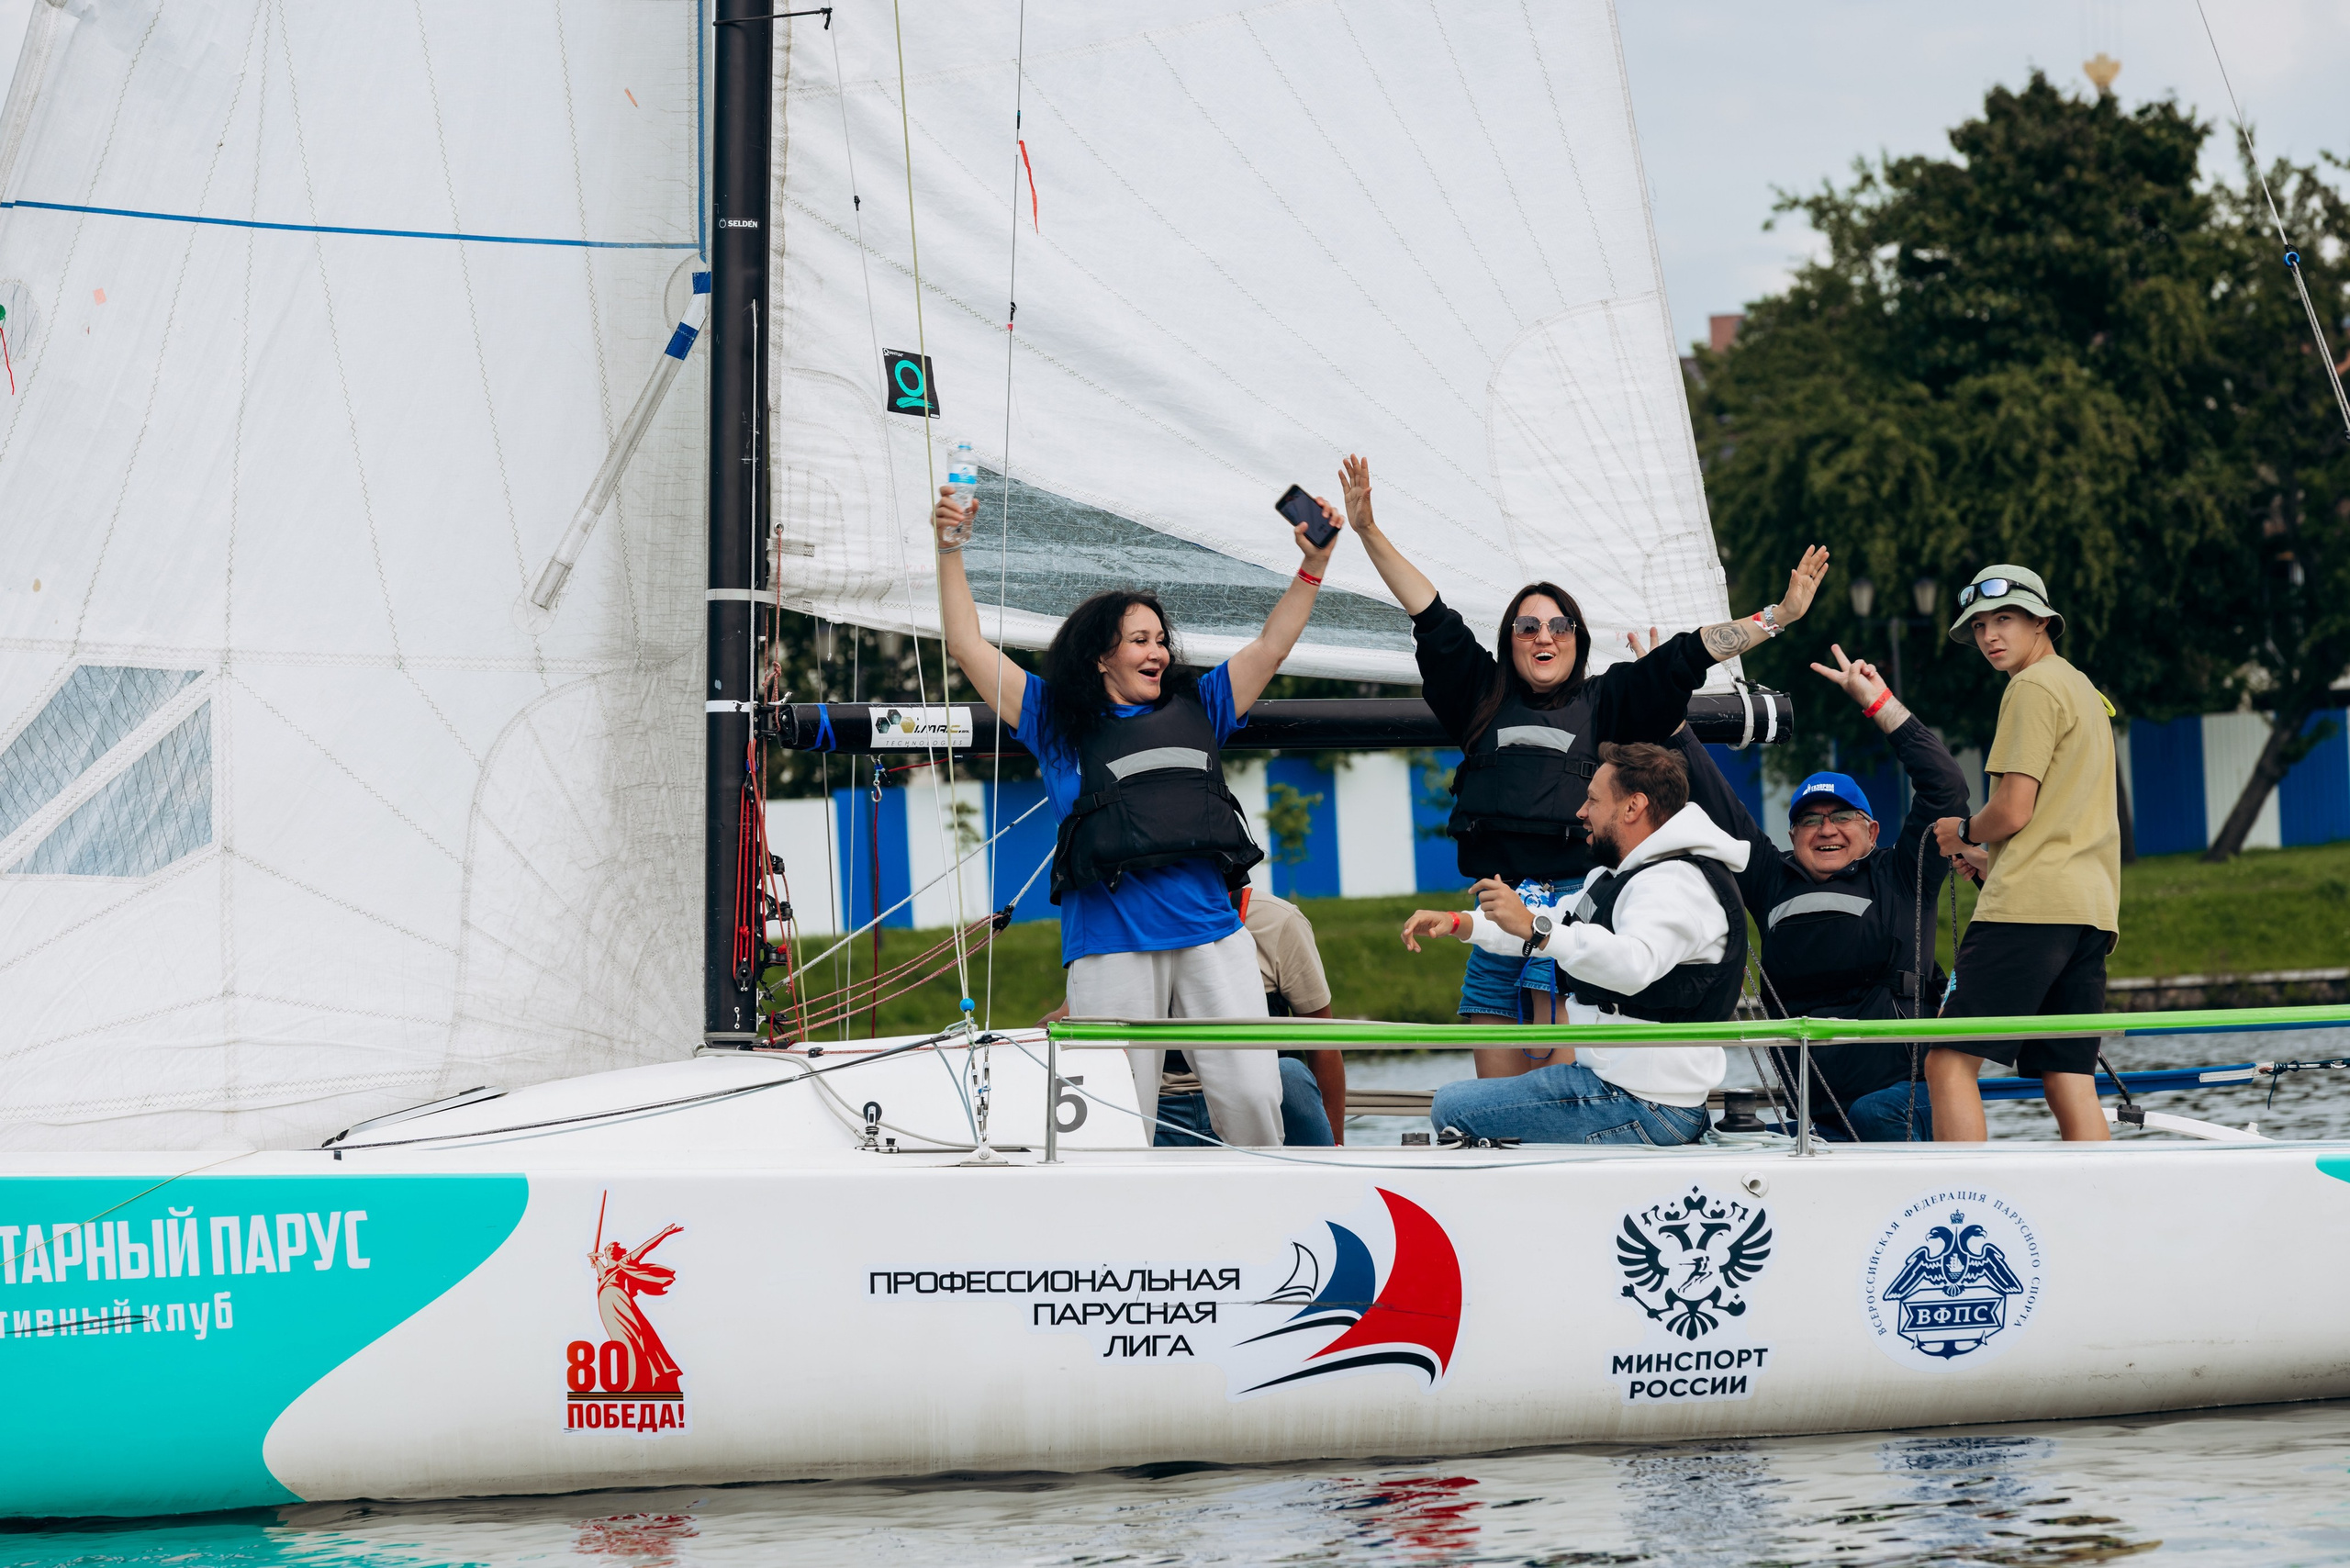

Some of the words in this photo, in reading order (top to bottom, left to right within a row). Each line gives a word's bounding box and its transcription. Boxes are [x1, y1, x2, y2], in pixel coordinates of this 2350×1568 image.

[728, 219, 758, 229] SELDÉN
[1055, 1075, 1088, 1133] 5
[1904, 1191, 1987, 1218] ФЕДЕРАЦИЯ
[0, 1206, 199, 1284] ТАРНЫЙ
[210, 1210, 371, 1275] ПАРУС
[1993, 1199, 2041, 1268] ПАРУСНОГО
[869, 1268, 1240, 1294] ПРОФЕССИОНАЛЬНАЯ
[1865, 1221, 1900, 1337] ВСЕРОССИЙСКАЯ
[142, 1291, 233, 1340] клуб
[1034, 1301, 1217, 1326] ПАРУСНАЯ
[1916, 1305, 1988, 1325] ВФПС
[2013, 1276, 2041, 1328] СПОРТА
[1103, 1334, 1195, 1357] ЛИГА
[566, 1340, 630, 1393] 80
[1612, 1348, 1769, 1375] МИНСПОРТ
[1629, 1374, 1748, 1400] РОССИИ
[567, 1403, 685, 1432] ПОБЕДА!
